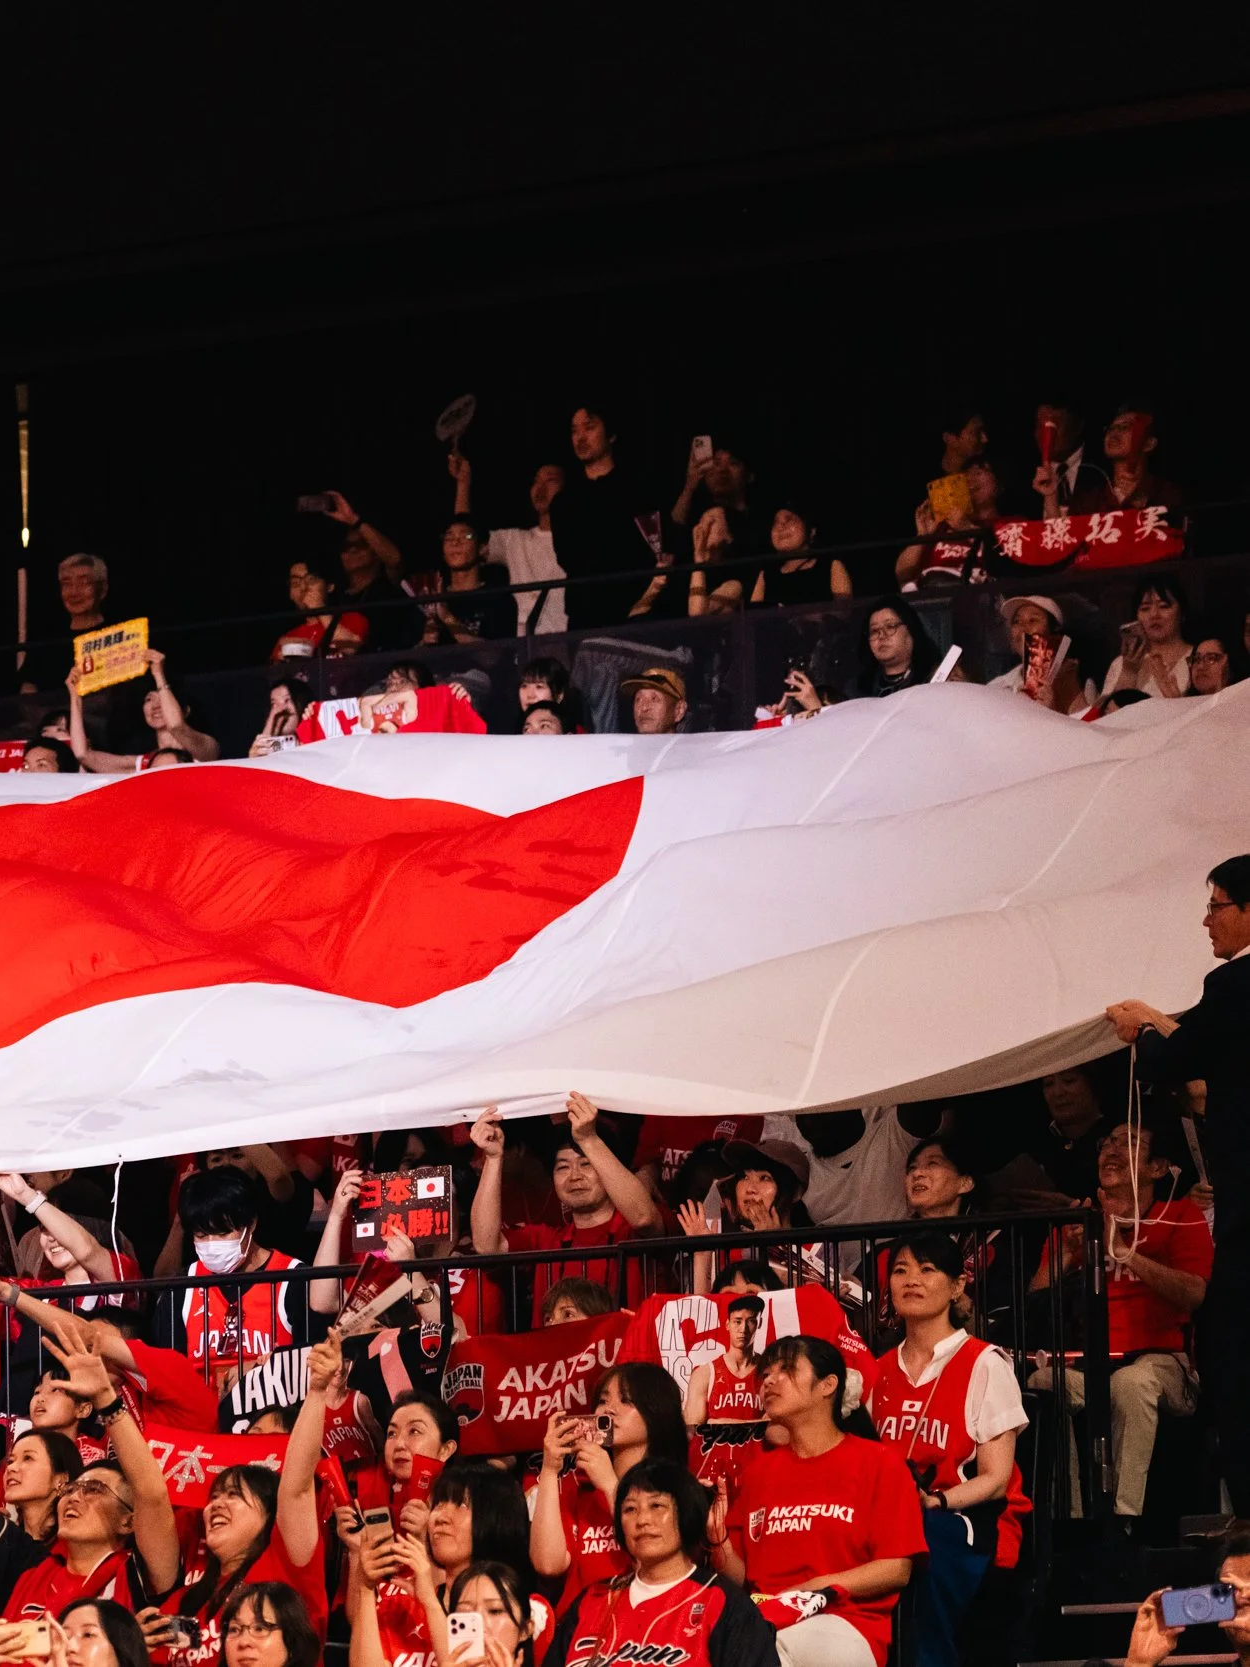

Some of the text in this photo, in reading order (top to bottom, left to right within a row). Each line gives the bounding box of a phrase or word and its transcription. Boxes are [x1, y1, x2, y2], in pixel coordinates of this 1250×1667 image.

[359, 1176, 412, 1208] 日本
[422, 1321, 446, 1333] JAPAN
[444, 1365, 483, 1390] JAPAN
[444, 1379, 483, 1399] BASKETBALL
[494, 1379, 588, 1423] JAPAN
[876, 1415, 950, 1450] APAN
[767, 1504, 855, 1523] AKATSUKI
[582, 1525, 615, 1540] AKA
[765, 1517, 812, 1535] JAPAN
